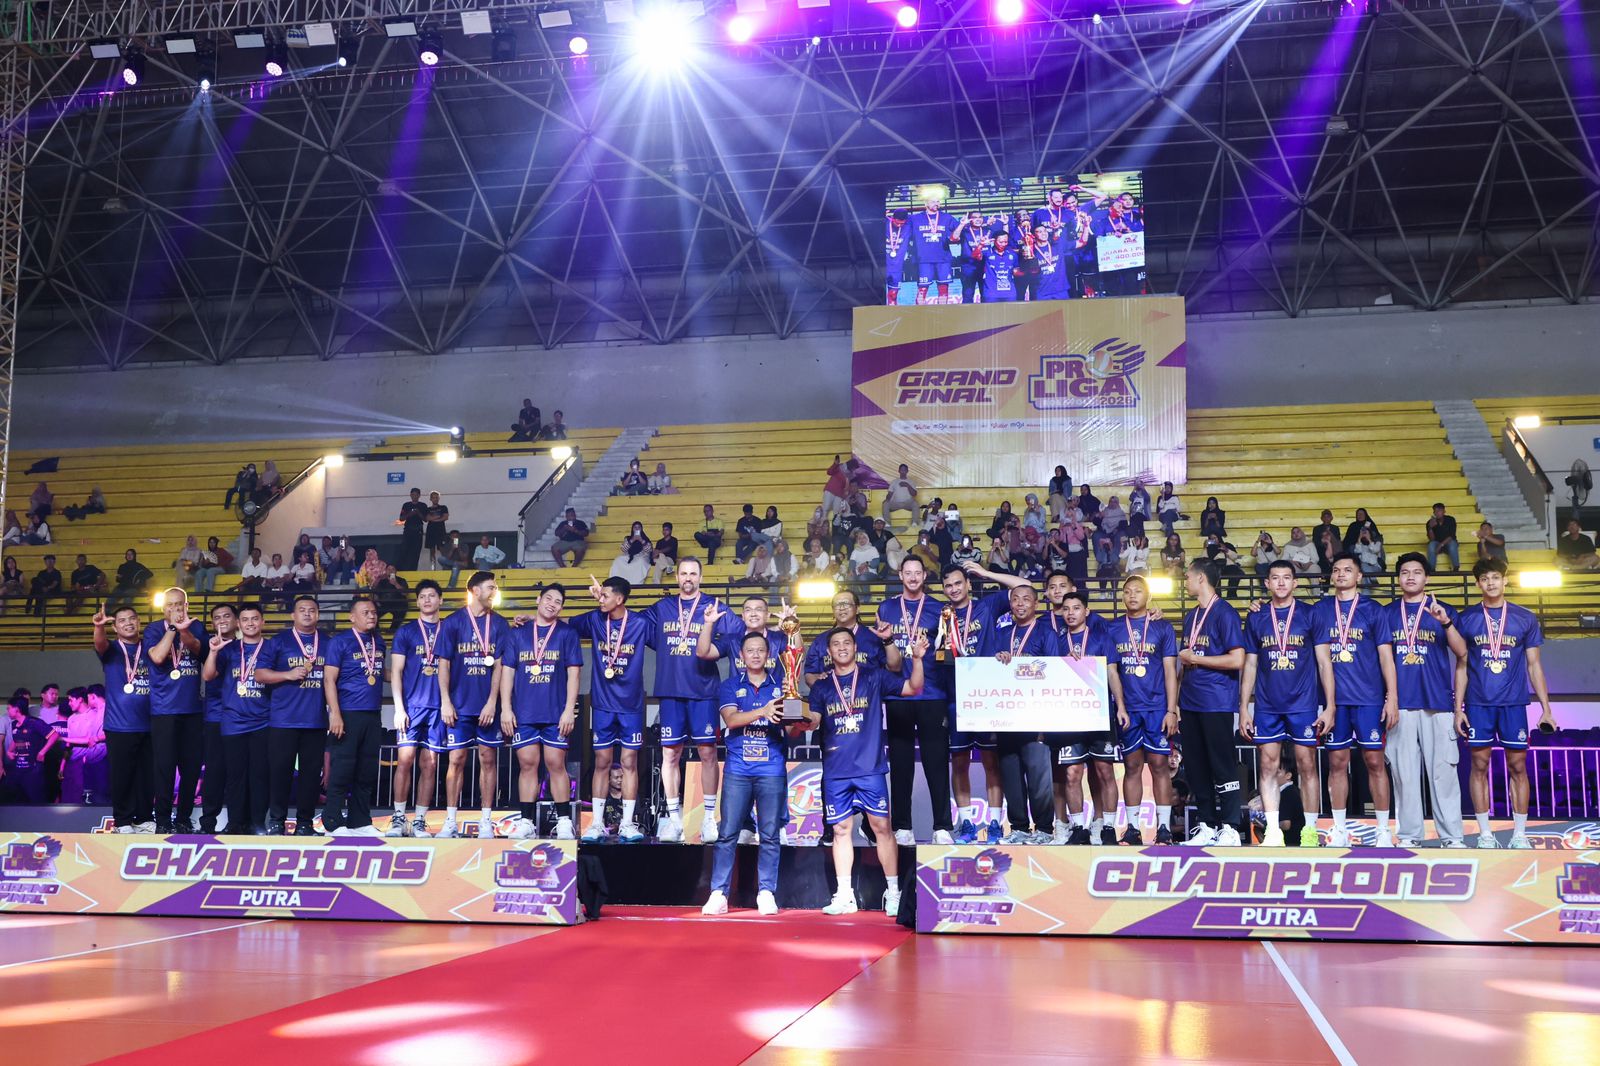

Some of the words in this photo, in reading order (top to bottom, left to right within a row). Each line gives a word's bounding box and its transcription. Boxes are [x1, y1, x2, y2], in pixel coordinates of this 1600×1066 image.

[898, 369, 1017, 387] GRAND
[1033, 376, 1130, 399] LIGA
[897, 387, 993, 405] FINAL
[1100, 396, 1133, 405] 2026
[529, 674, 551, 684] 2026
[968, 688, 1024, 698] JUARA
[1041, 688, 1096, 698] PUTRA
[962, 701, 988, 710] RP.
[632, 733, 642, 743] 10
[661, 727, 672, 738] 99
[1061, 746, 1072, 757] 12
[826, 805, 836, 817] 15
[122, 847, 431, 882] CHAMPIONS
[1091, 859, 1475, 897] CHAMPIONS
[239, 889, 302, 908] PUTRA
[494, 892, 564, 906] GRAND
[493, 903, 548, 916] FINAL
[937, 901, 1014, 914] GRAND
[936, 912, 998, 925] FINAL
[1240, 907, 1319, 927] PUTRA
